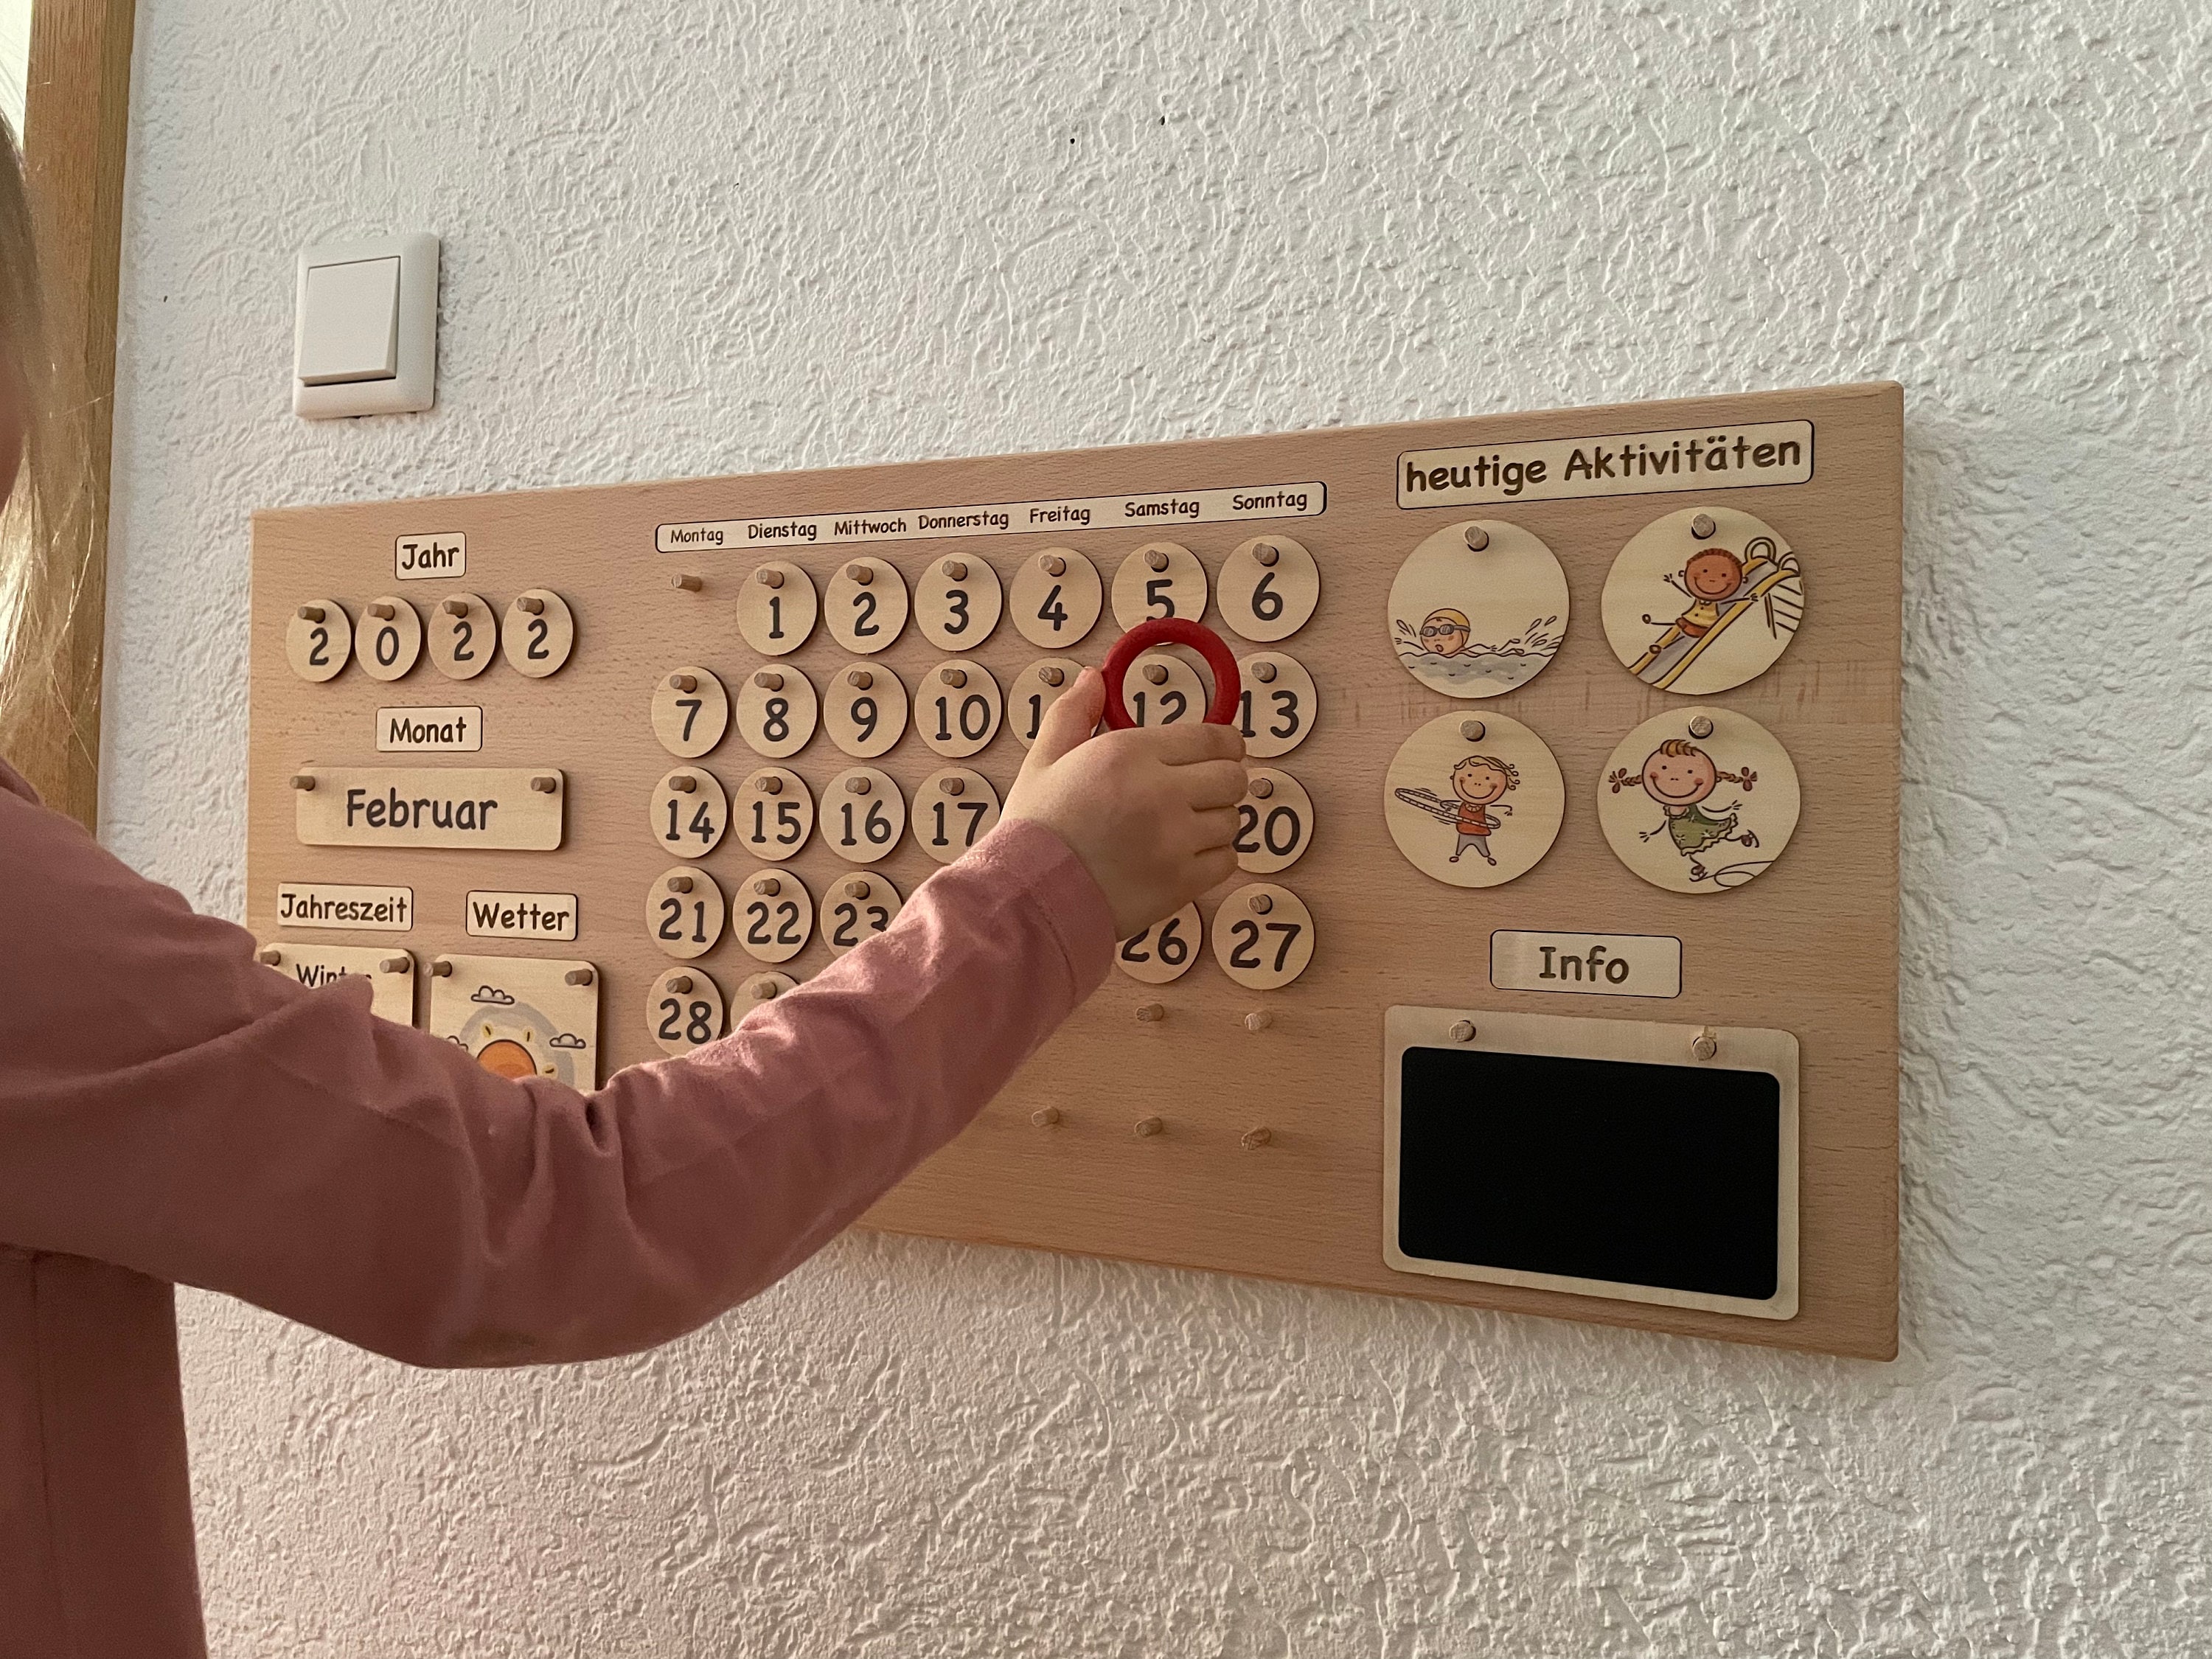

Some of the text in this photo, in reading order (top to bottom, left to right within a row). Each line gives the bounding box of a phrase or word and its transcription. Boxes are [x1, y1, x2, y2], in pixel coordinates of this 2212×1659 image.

[1406, 435, 1801, 496] heutige Aktivitäten
[670, 491, 1308, 545] Montag Dienstag Mittwoch Donnerstag Freitag Samstag Sonntag
[401, 543, 460, 571] Jahr
[768, 571, 1284, 639] 1 2 3 4 5 6
[389, 718, 467, 743] Monat
[675, 699, 703, 742] 7
[762, 698, 790, 742] 8
[850, 697, 878, 742] 9
[935, 694, 991, 741] 10
[1239, 689, 1300, 739] 13
[346, 788, 498, 831] Februar
[665, 799, 1301, 856] 14 15 16 17 20
[280, 893, 408, 925] Jahreszeit
[473, 902, 571, 933] Wetter
[658, 897, 1301, 972] 21 22 23 26 27
[1538, 945, 1630, 984] Info
[658, 998, 712, 1044] 28
